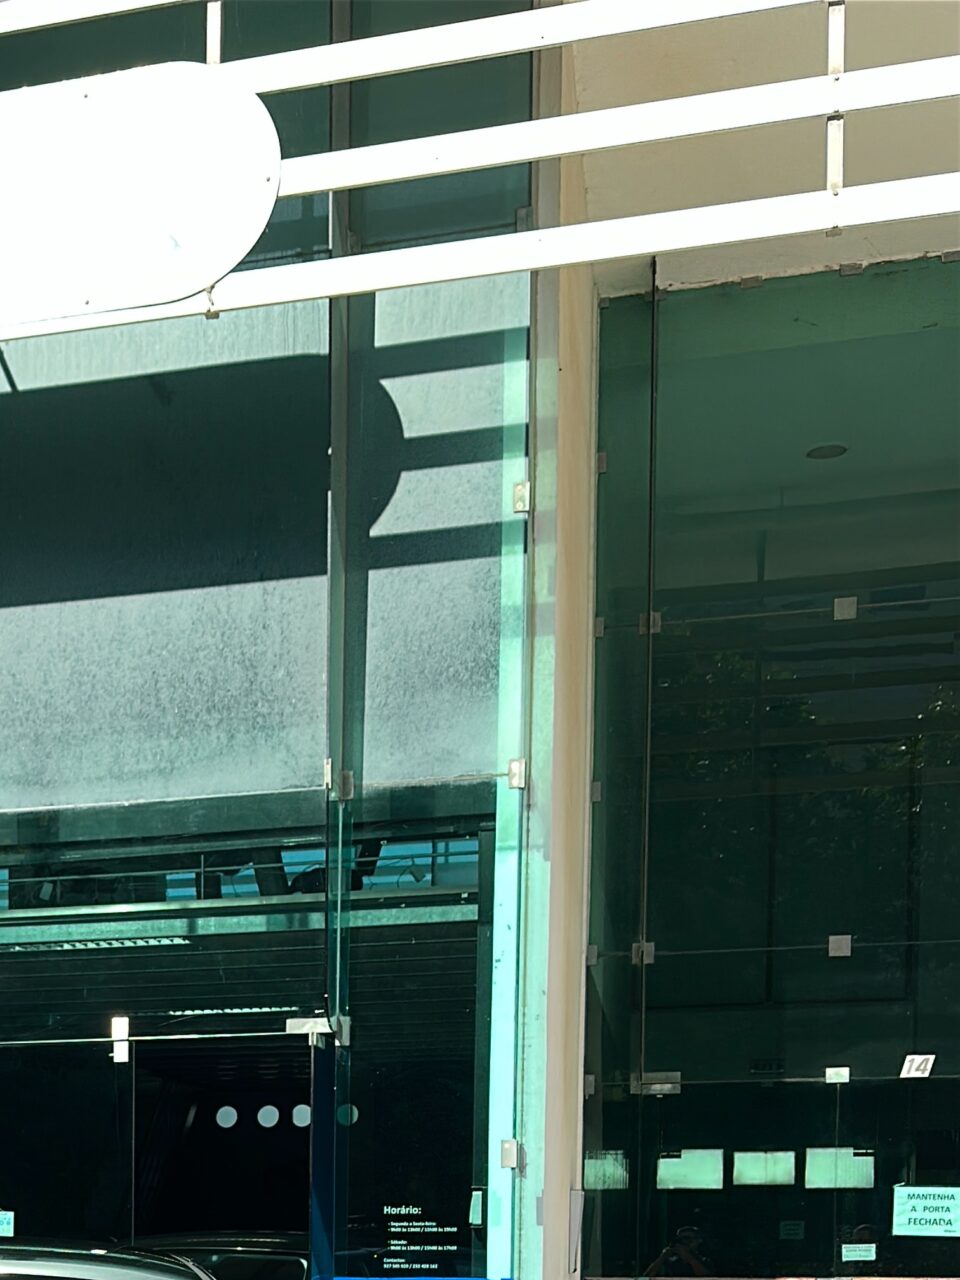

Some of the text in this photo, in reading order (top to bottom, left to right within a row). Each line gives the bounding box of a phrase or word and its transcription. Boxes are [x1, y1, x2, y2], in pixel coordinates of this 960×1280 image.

[906, 1057, 930, 1075] 14
[383, 1205, 422, 1214] Horário:
[923, 1205, 951, 1213] PORTA
[908, 1217, 953, 1226] FECHADA
